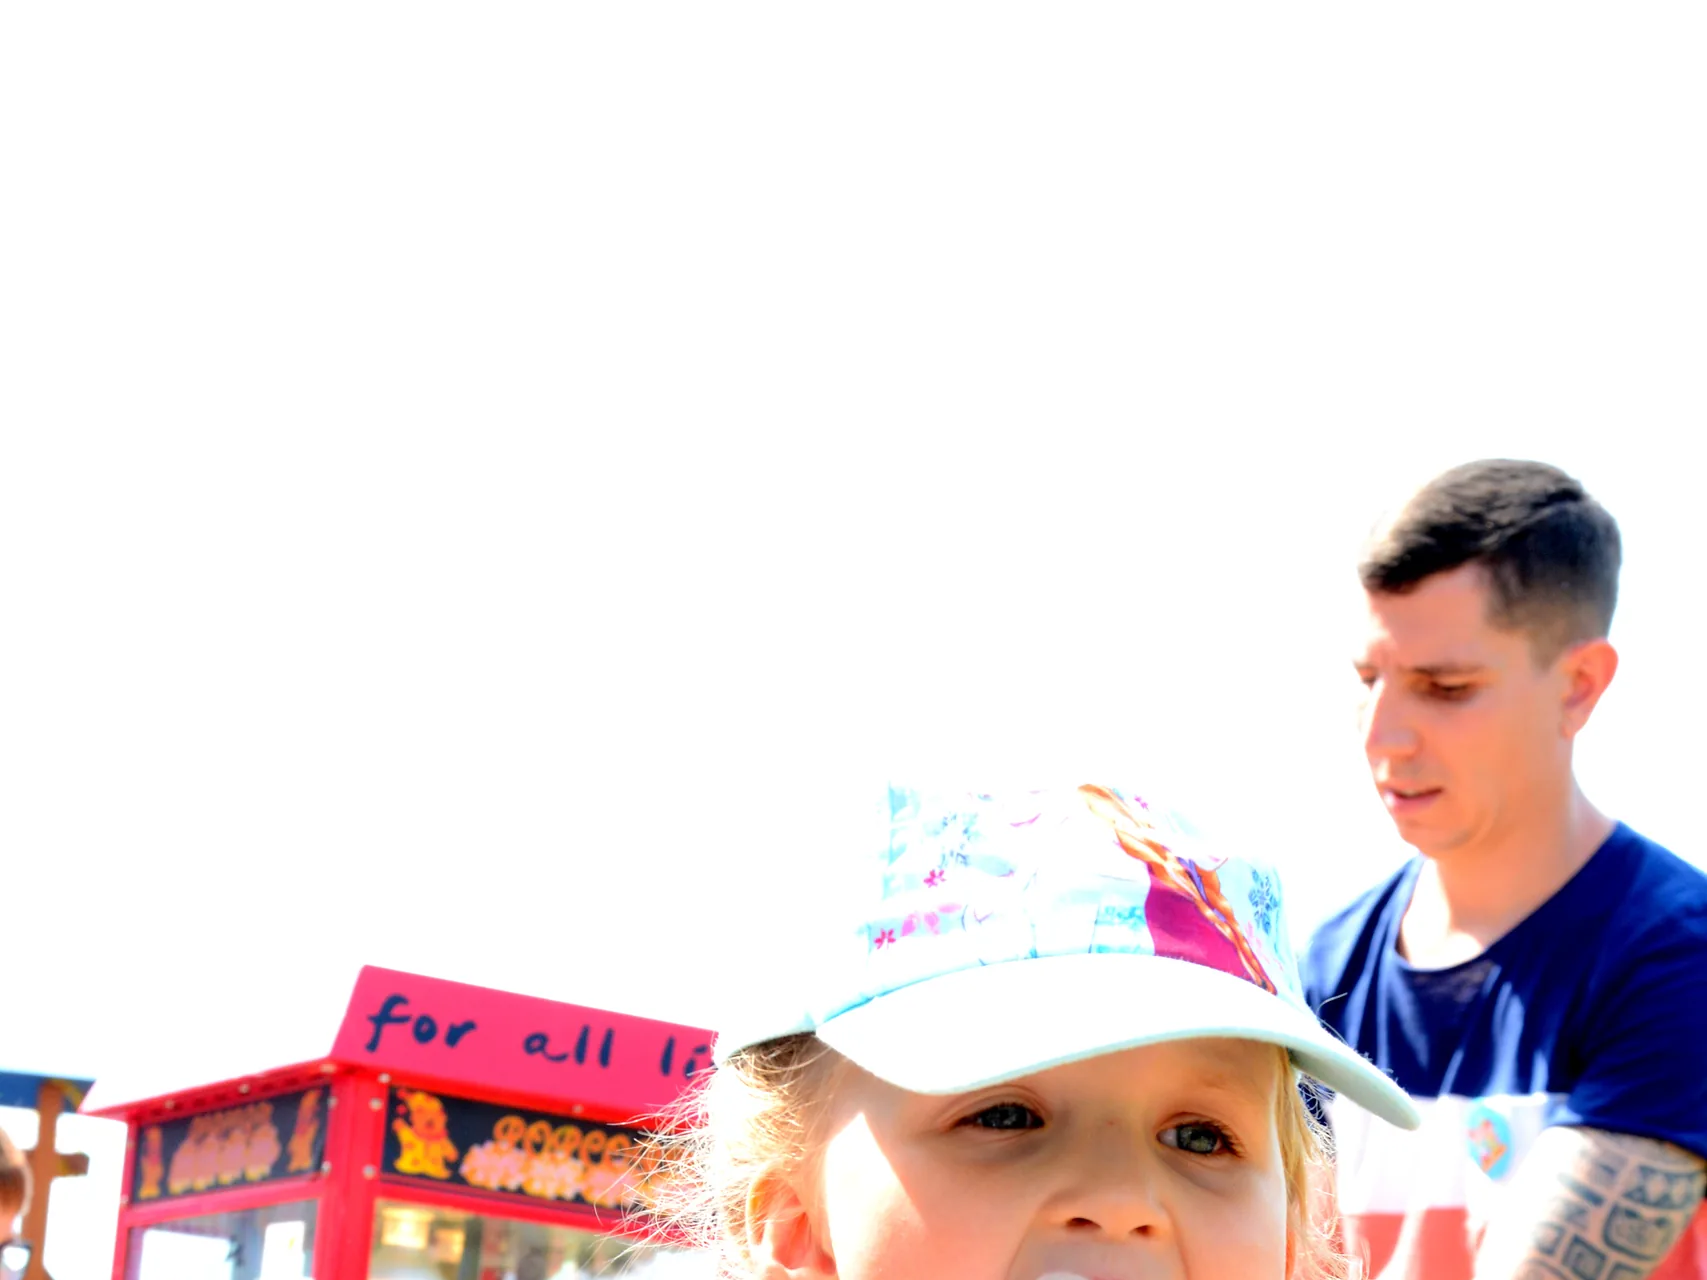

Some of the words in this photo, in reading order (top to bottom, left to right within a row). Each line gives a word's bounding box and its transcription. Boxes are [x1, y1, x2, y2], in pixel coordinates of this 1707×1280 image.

[365, 993, 477, 1053] for
[524, 1024, 615, 1068] all
[660, 1036, 718, 1080] li
